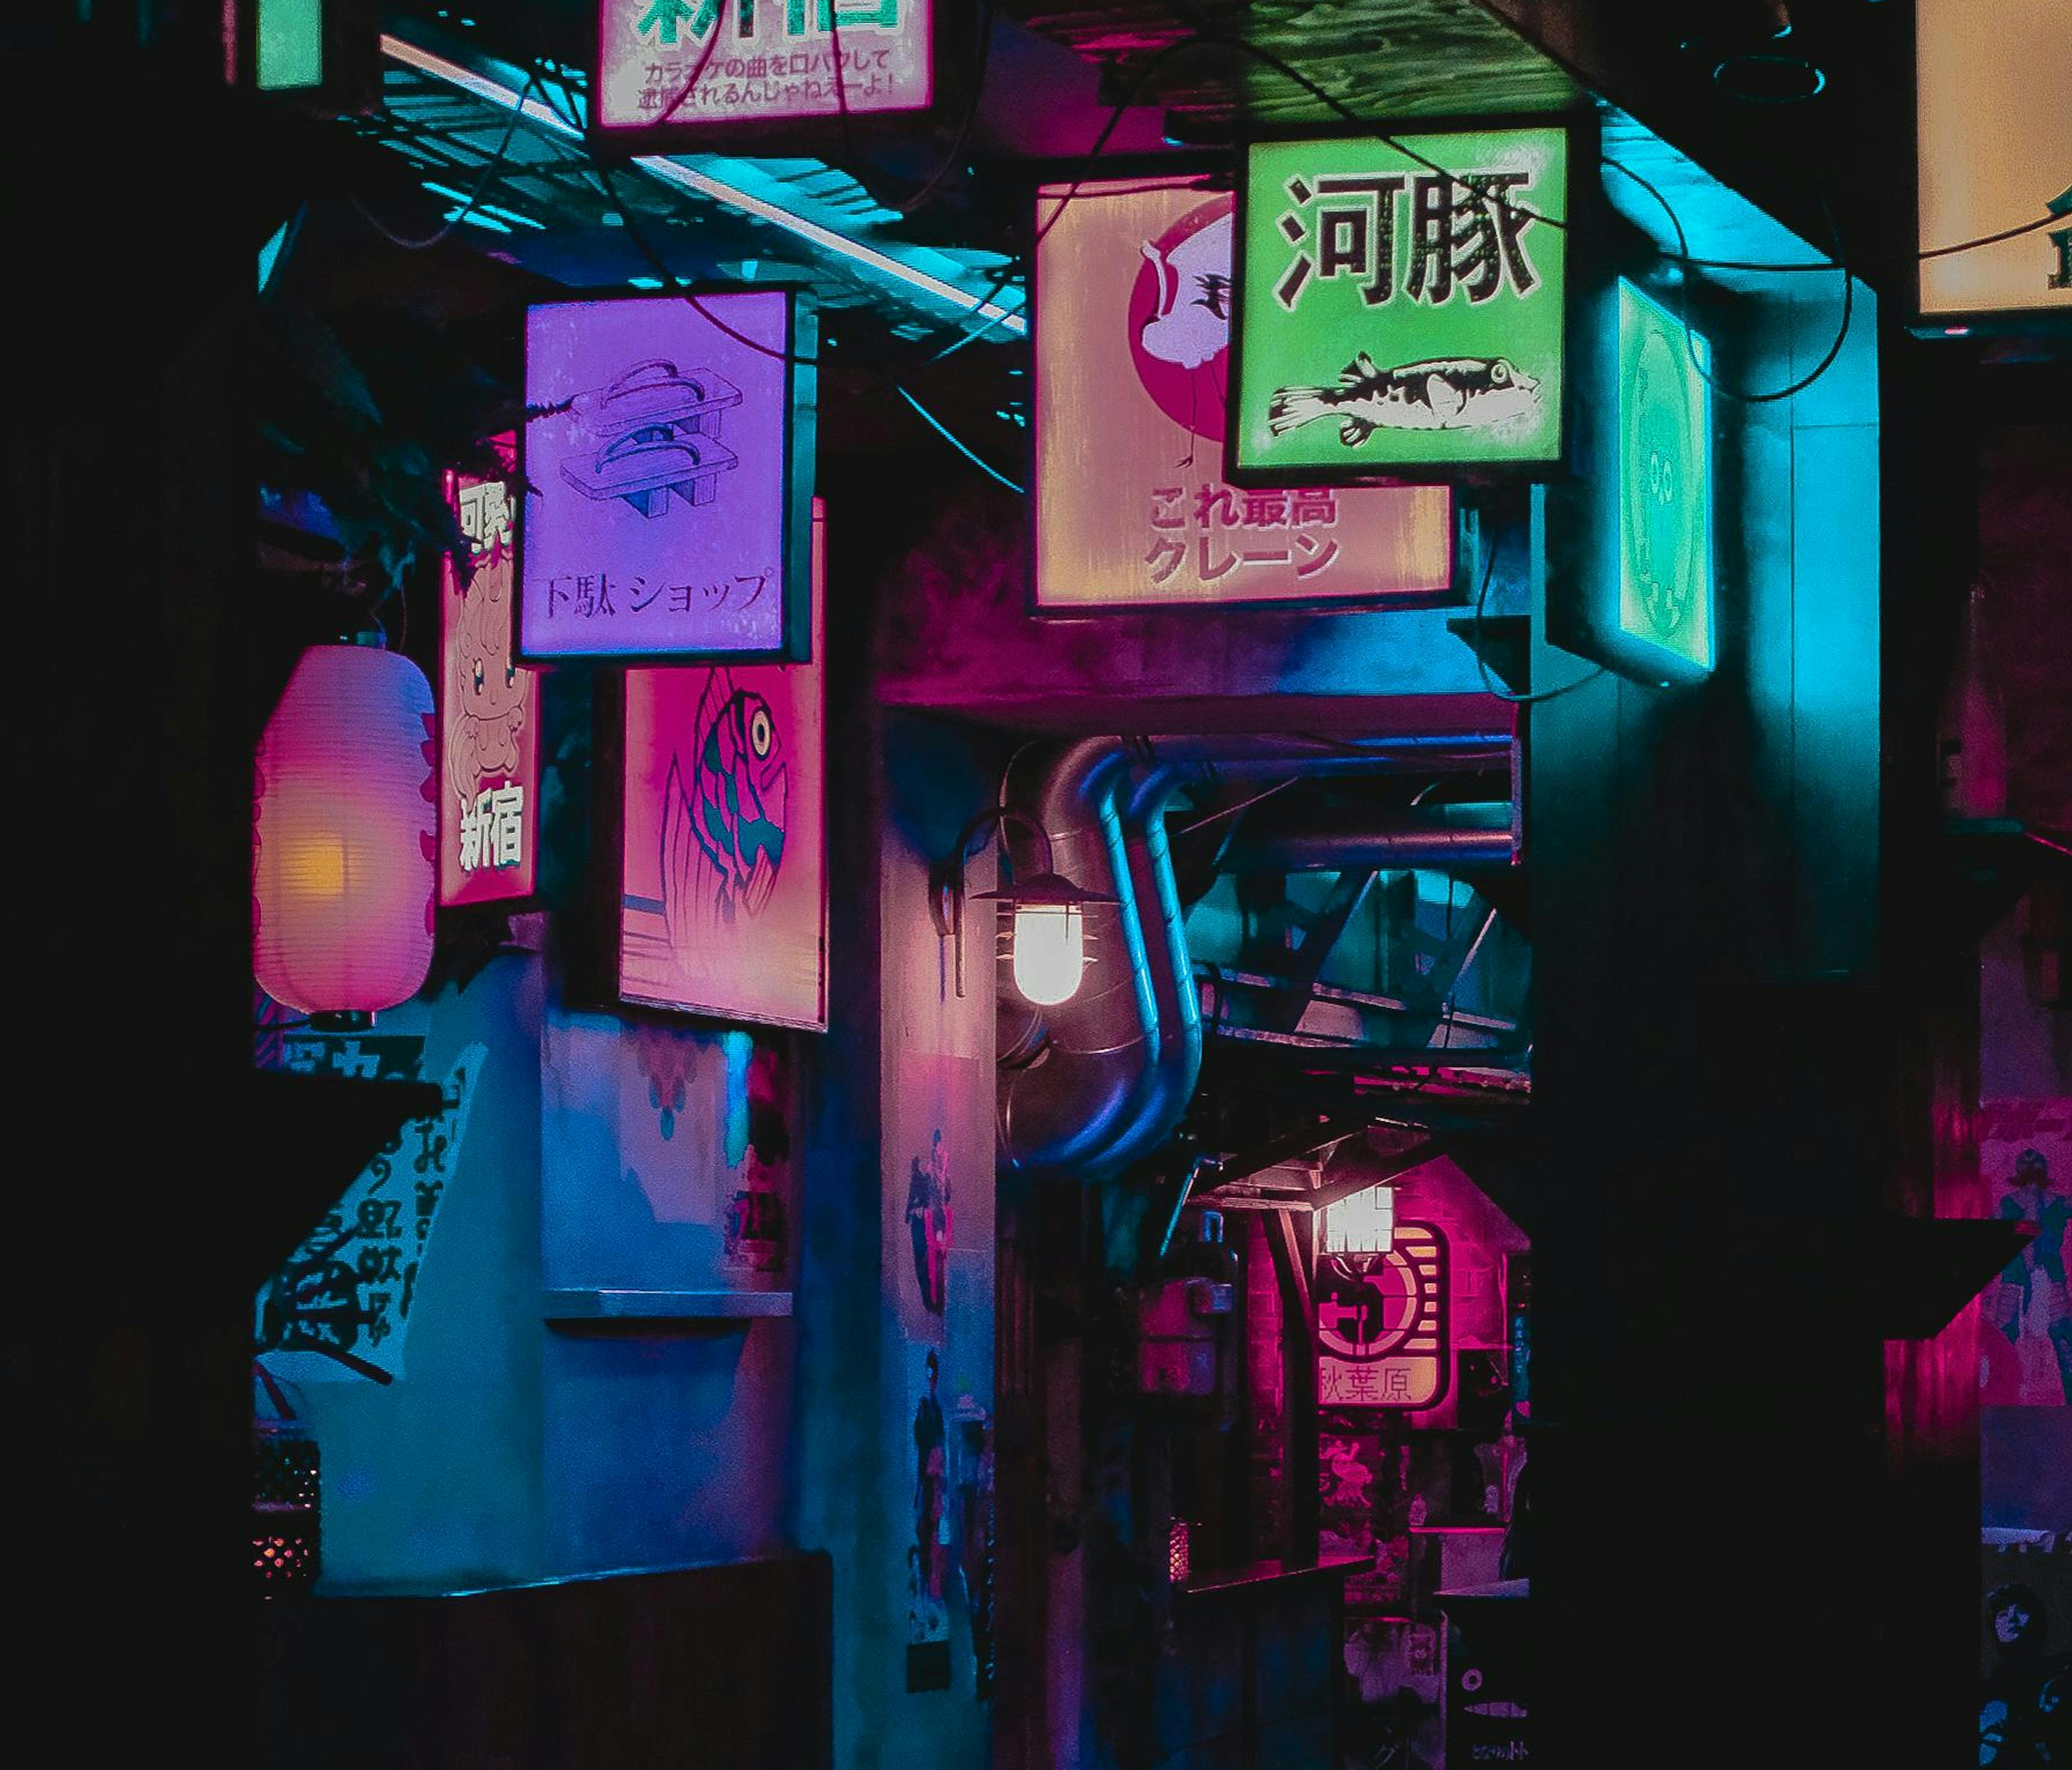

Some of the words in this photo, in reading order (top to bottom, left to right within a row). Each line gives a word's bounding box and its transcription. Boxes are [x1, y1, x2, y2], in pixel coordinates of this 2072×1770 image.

[1276, 170, 1538, 309] 河豚
[1152, 484, 1338, 528] これ最高
[1145, 533, 1339, 585] クレーン
[460, 780, 524, 871] 新宿
[1320, 1365, 1412, 1402] 秋葉原
